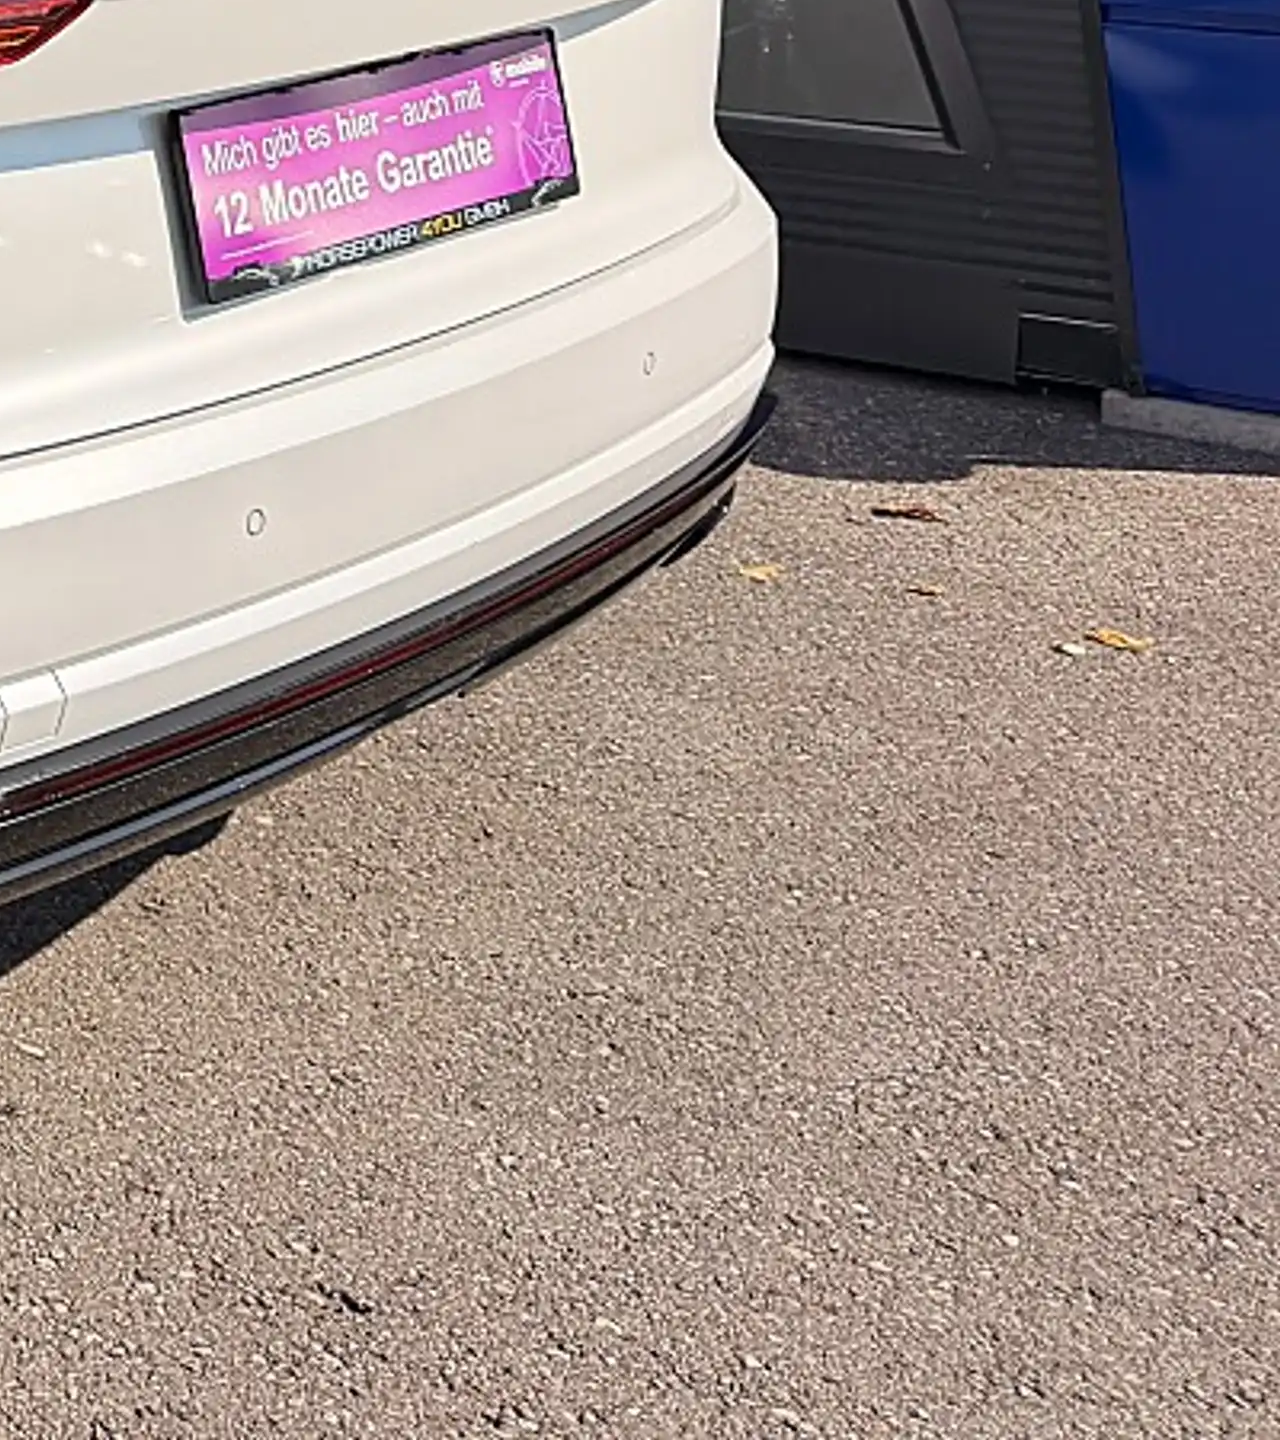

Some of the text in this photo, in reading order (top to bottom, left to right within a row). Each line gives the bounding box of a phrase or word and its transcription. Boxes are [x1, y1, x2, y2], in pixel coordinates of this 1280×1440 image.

[201, 139, 258, 177] Mich
[262, 123, 303, 172] gibt
[306, 121, 332, 150] es
[336, 107, 379, 144] hier
[402, 89, 451, 126] auch
[451, 79, 485, 113] mit
[214, 191, 254, 239] 12
[257, 165, 371, 228] Monate
